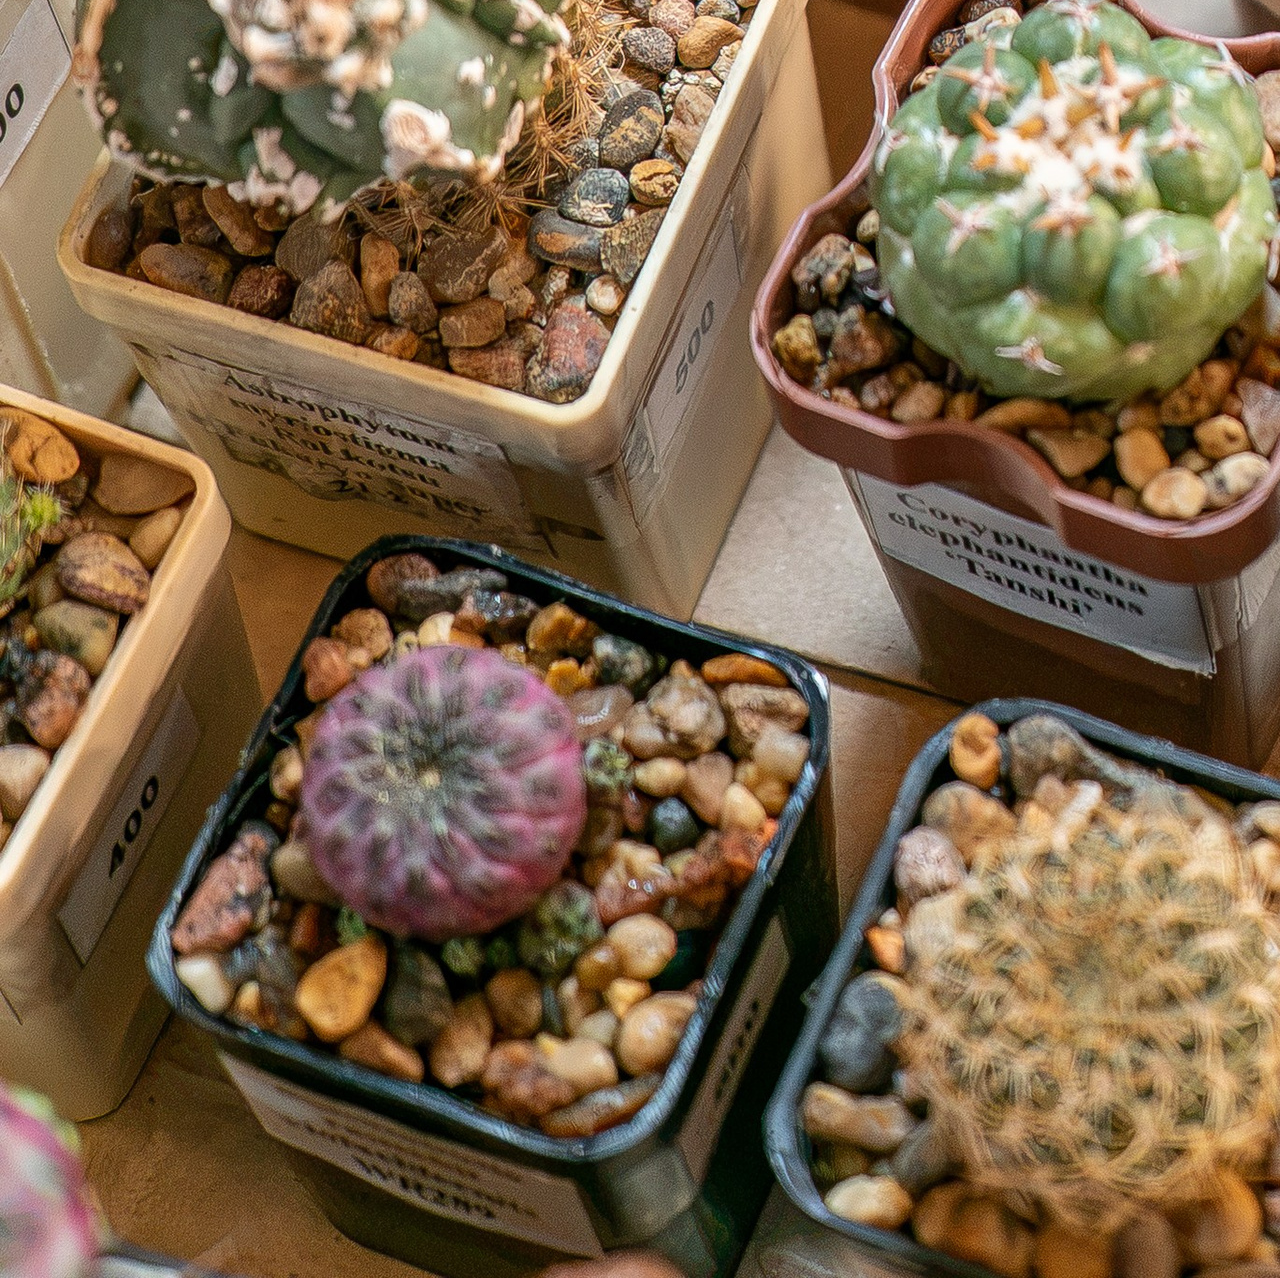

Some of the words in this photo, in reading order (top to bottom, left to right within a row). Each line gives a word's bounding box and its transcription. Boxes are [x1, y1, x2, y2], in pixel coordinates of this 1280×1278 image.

[675, 299, 716, 396] 500
[222, 372, 456, 455] Astrophytum
[888, 509, 1145, 616] elephantidens
[897, 491, 1149, 597] Coryphantha
[108, 774, 160, 878] 400
